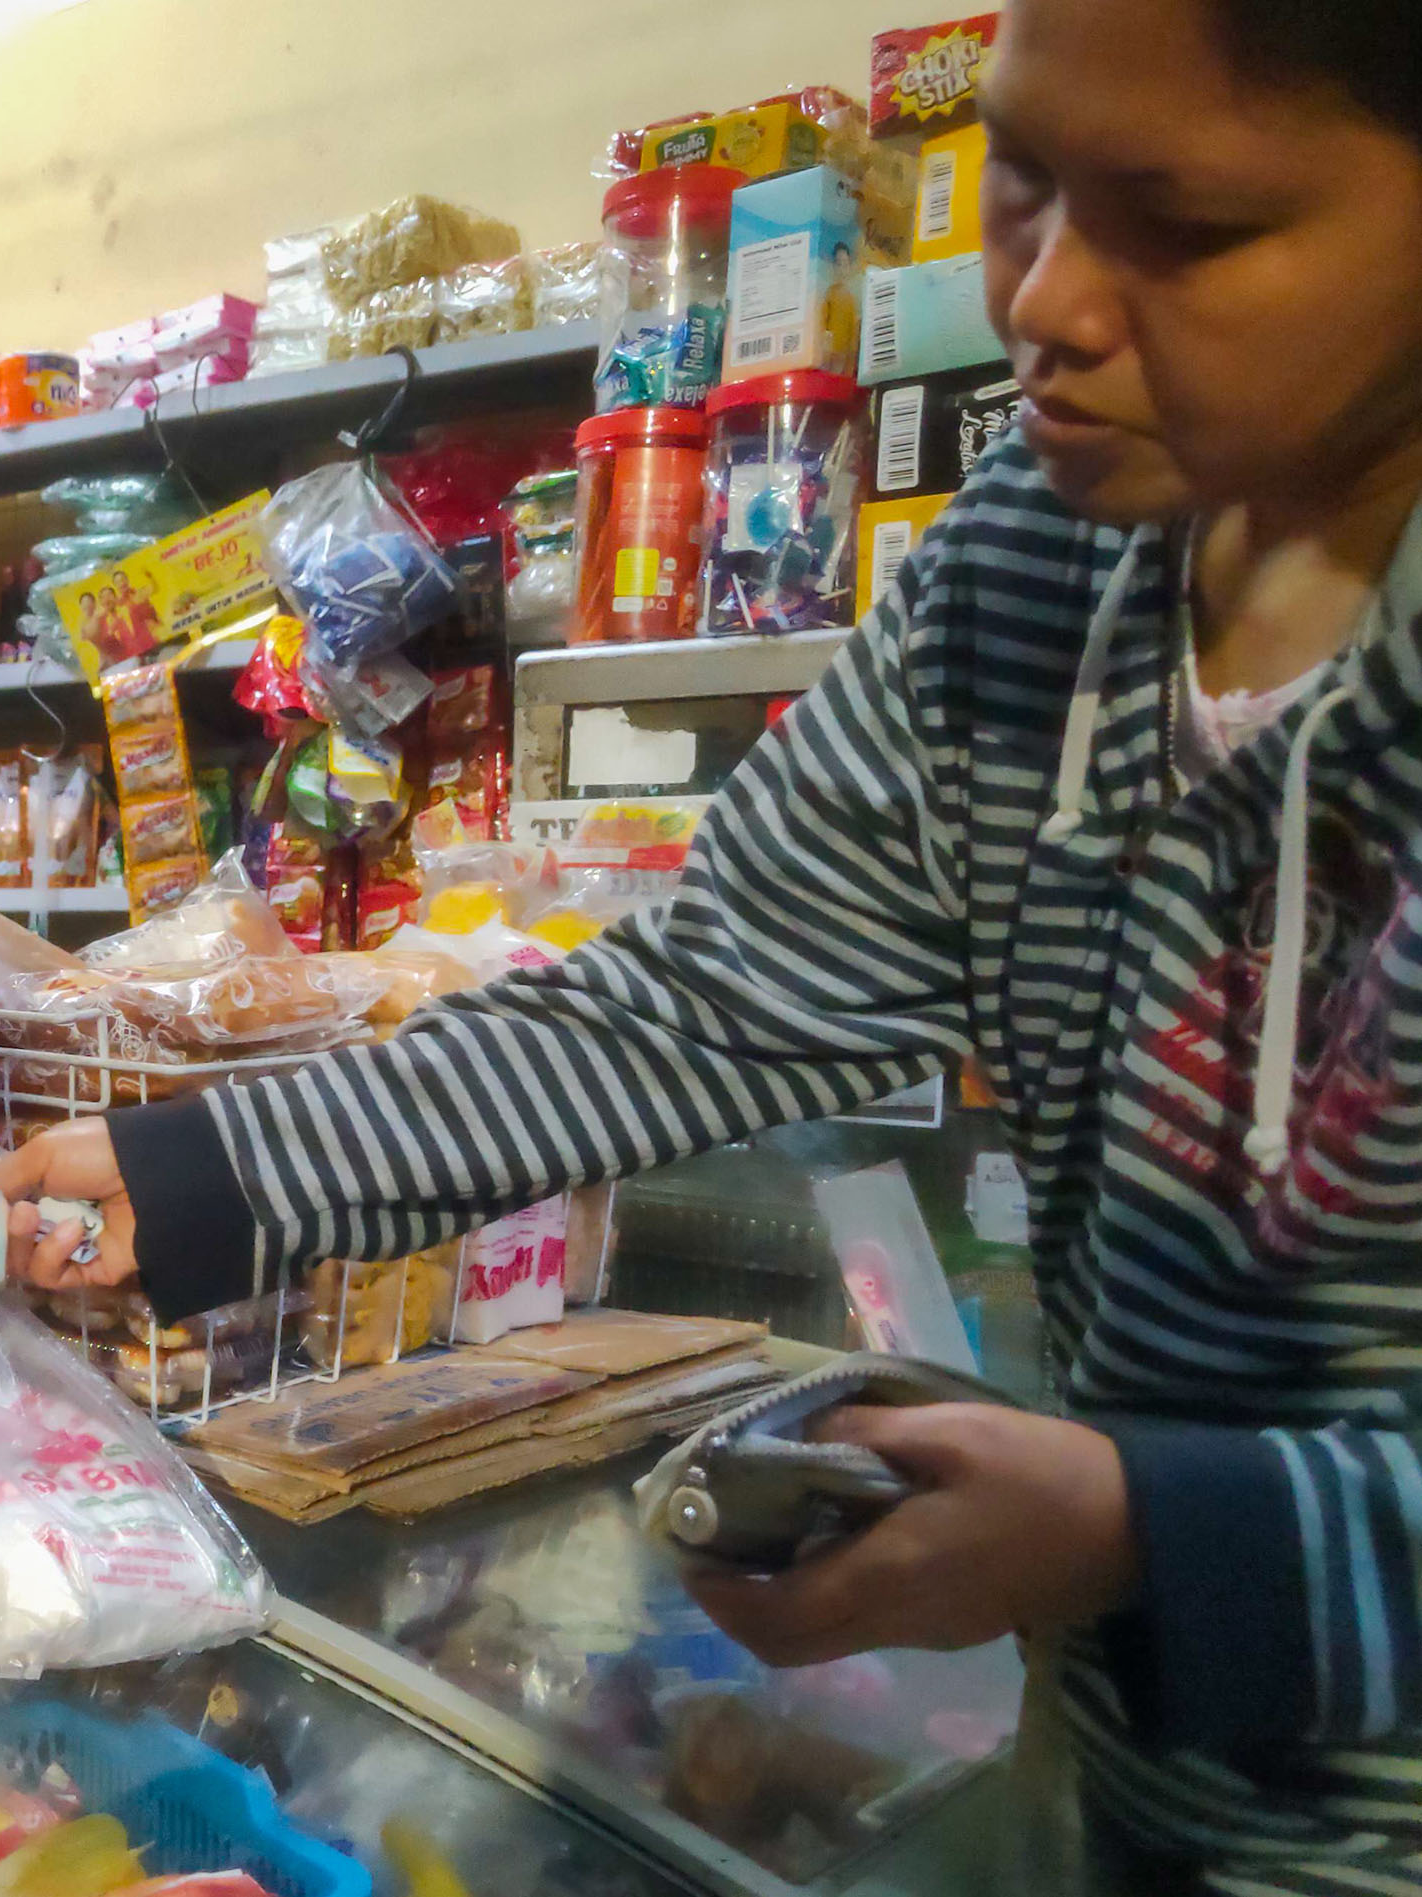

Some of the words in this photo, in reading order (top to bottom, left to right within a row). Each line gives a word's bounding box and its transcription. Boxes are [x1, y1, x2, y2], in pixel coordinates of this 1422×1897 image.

[899, 38, 980, 97] CHOKI
[918, 65, 971, 109] STIX
[682, 316, 705, 370] Relaxa
[664, 383, 712, 407] elaxa
